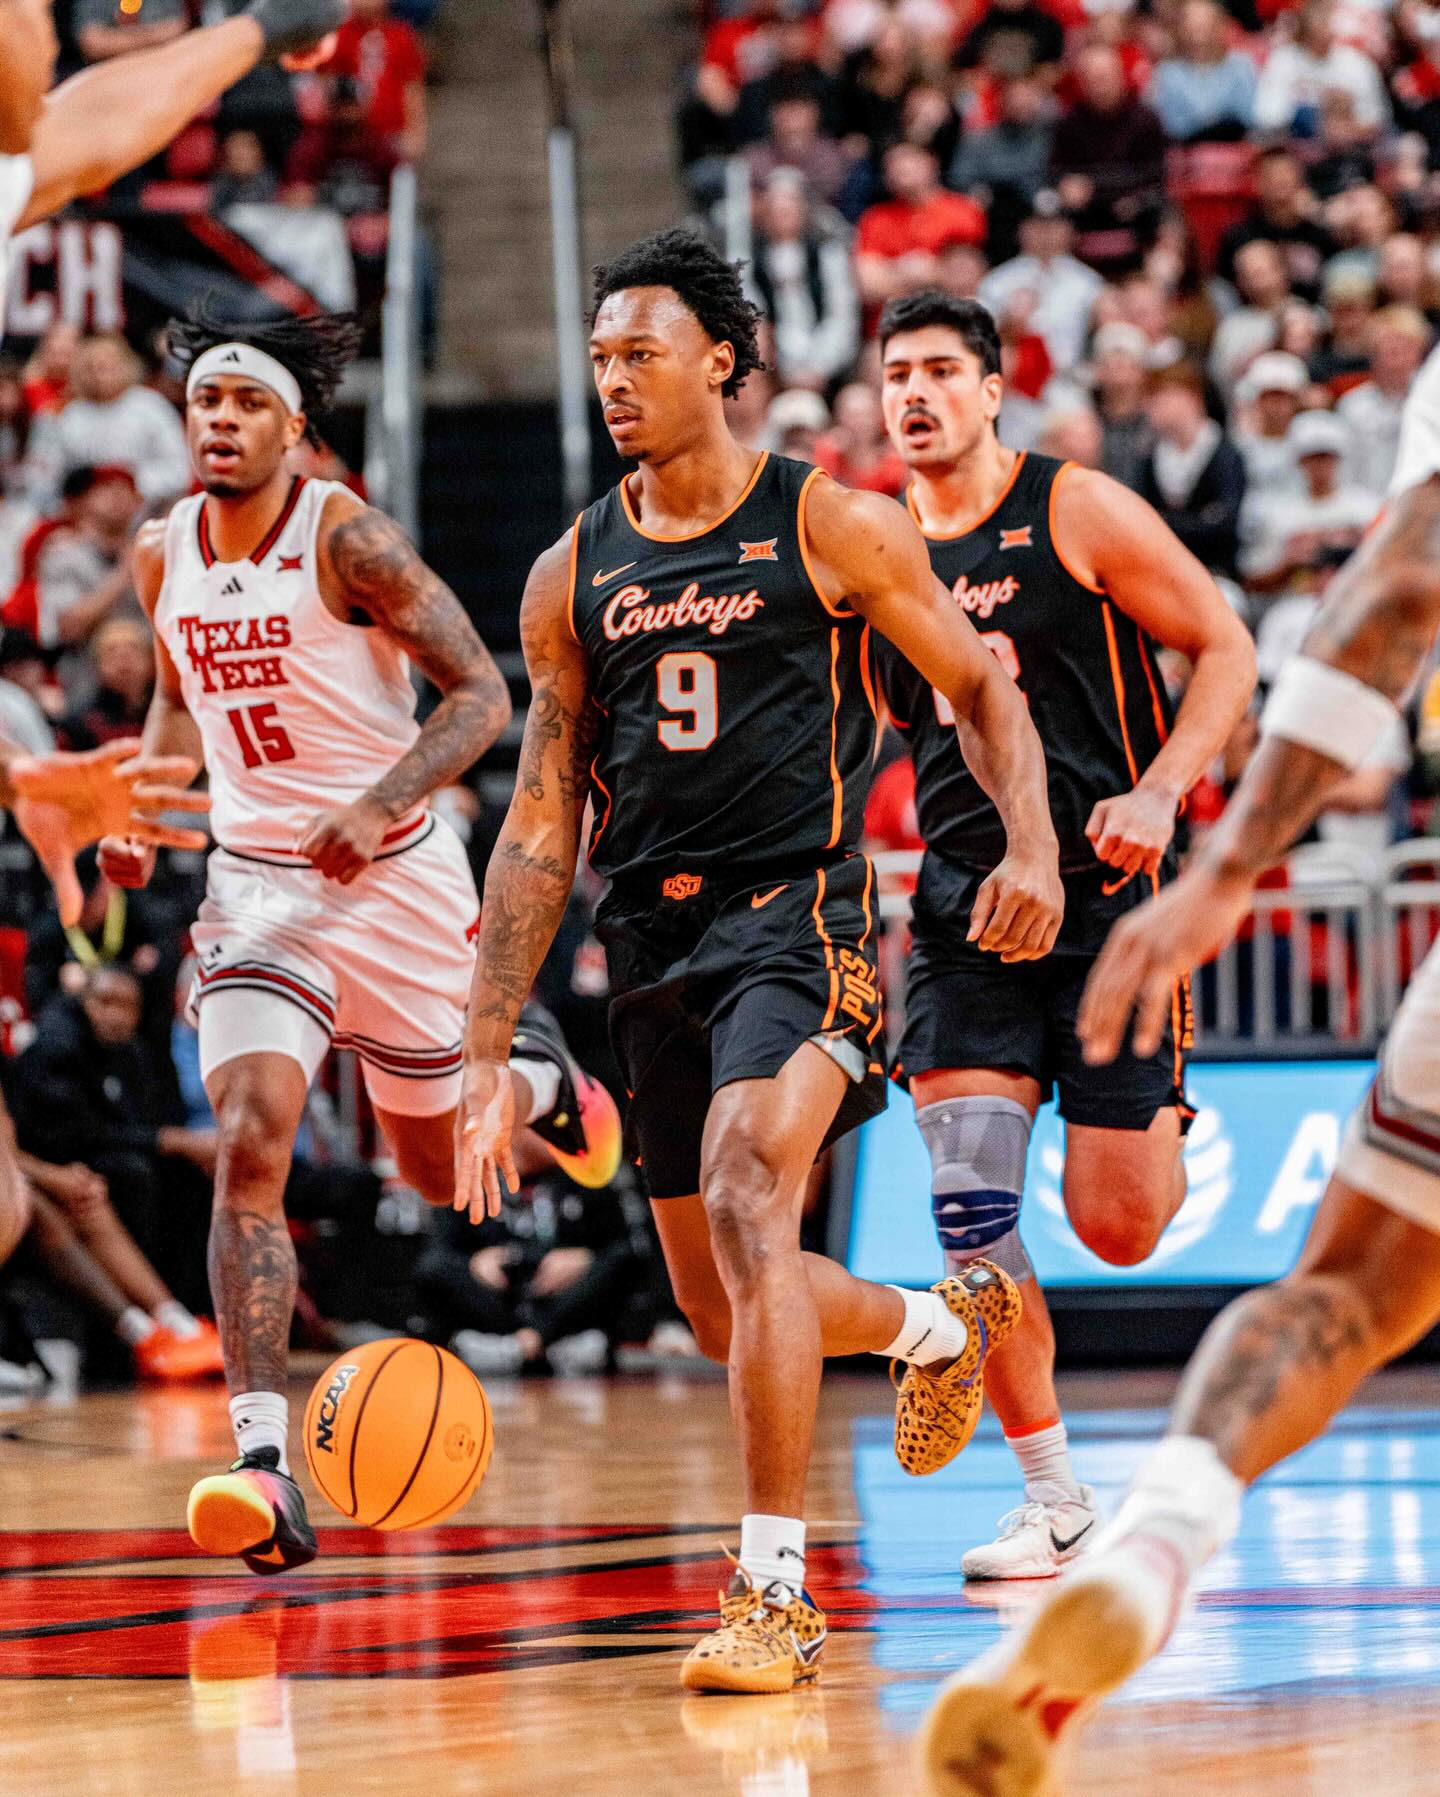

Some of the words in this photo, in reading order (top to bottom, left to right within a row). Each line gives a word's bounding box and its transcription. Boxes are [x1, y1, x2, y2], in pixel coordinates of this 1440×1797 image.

[177, 615, 292, 657] TEXAS
[603, 582, 765, 641] Cowboys
[190, 654, 289, 693] TECH
[656, 651, 719, 752] 9
[227, 701, 296, 769] 15
[664, 874, 702, 900] OSU
[840, 948, 877, 1025] POS
[316, 1364, 360, 1454] NCAA
